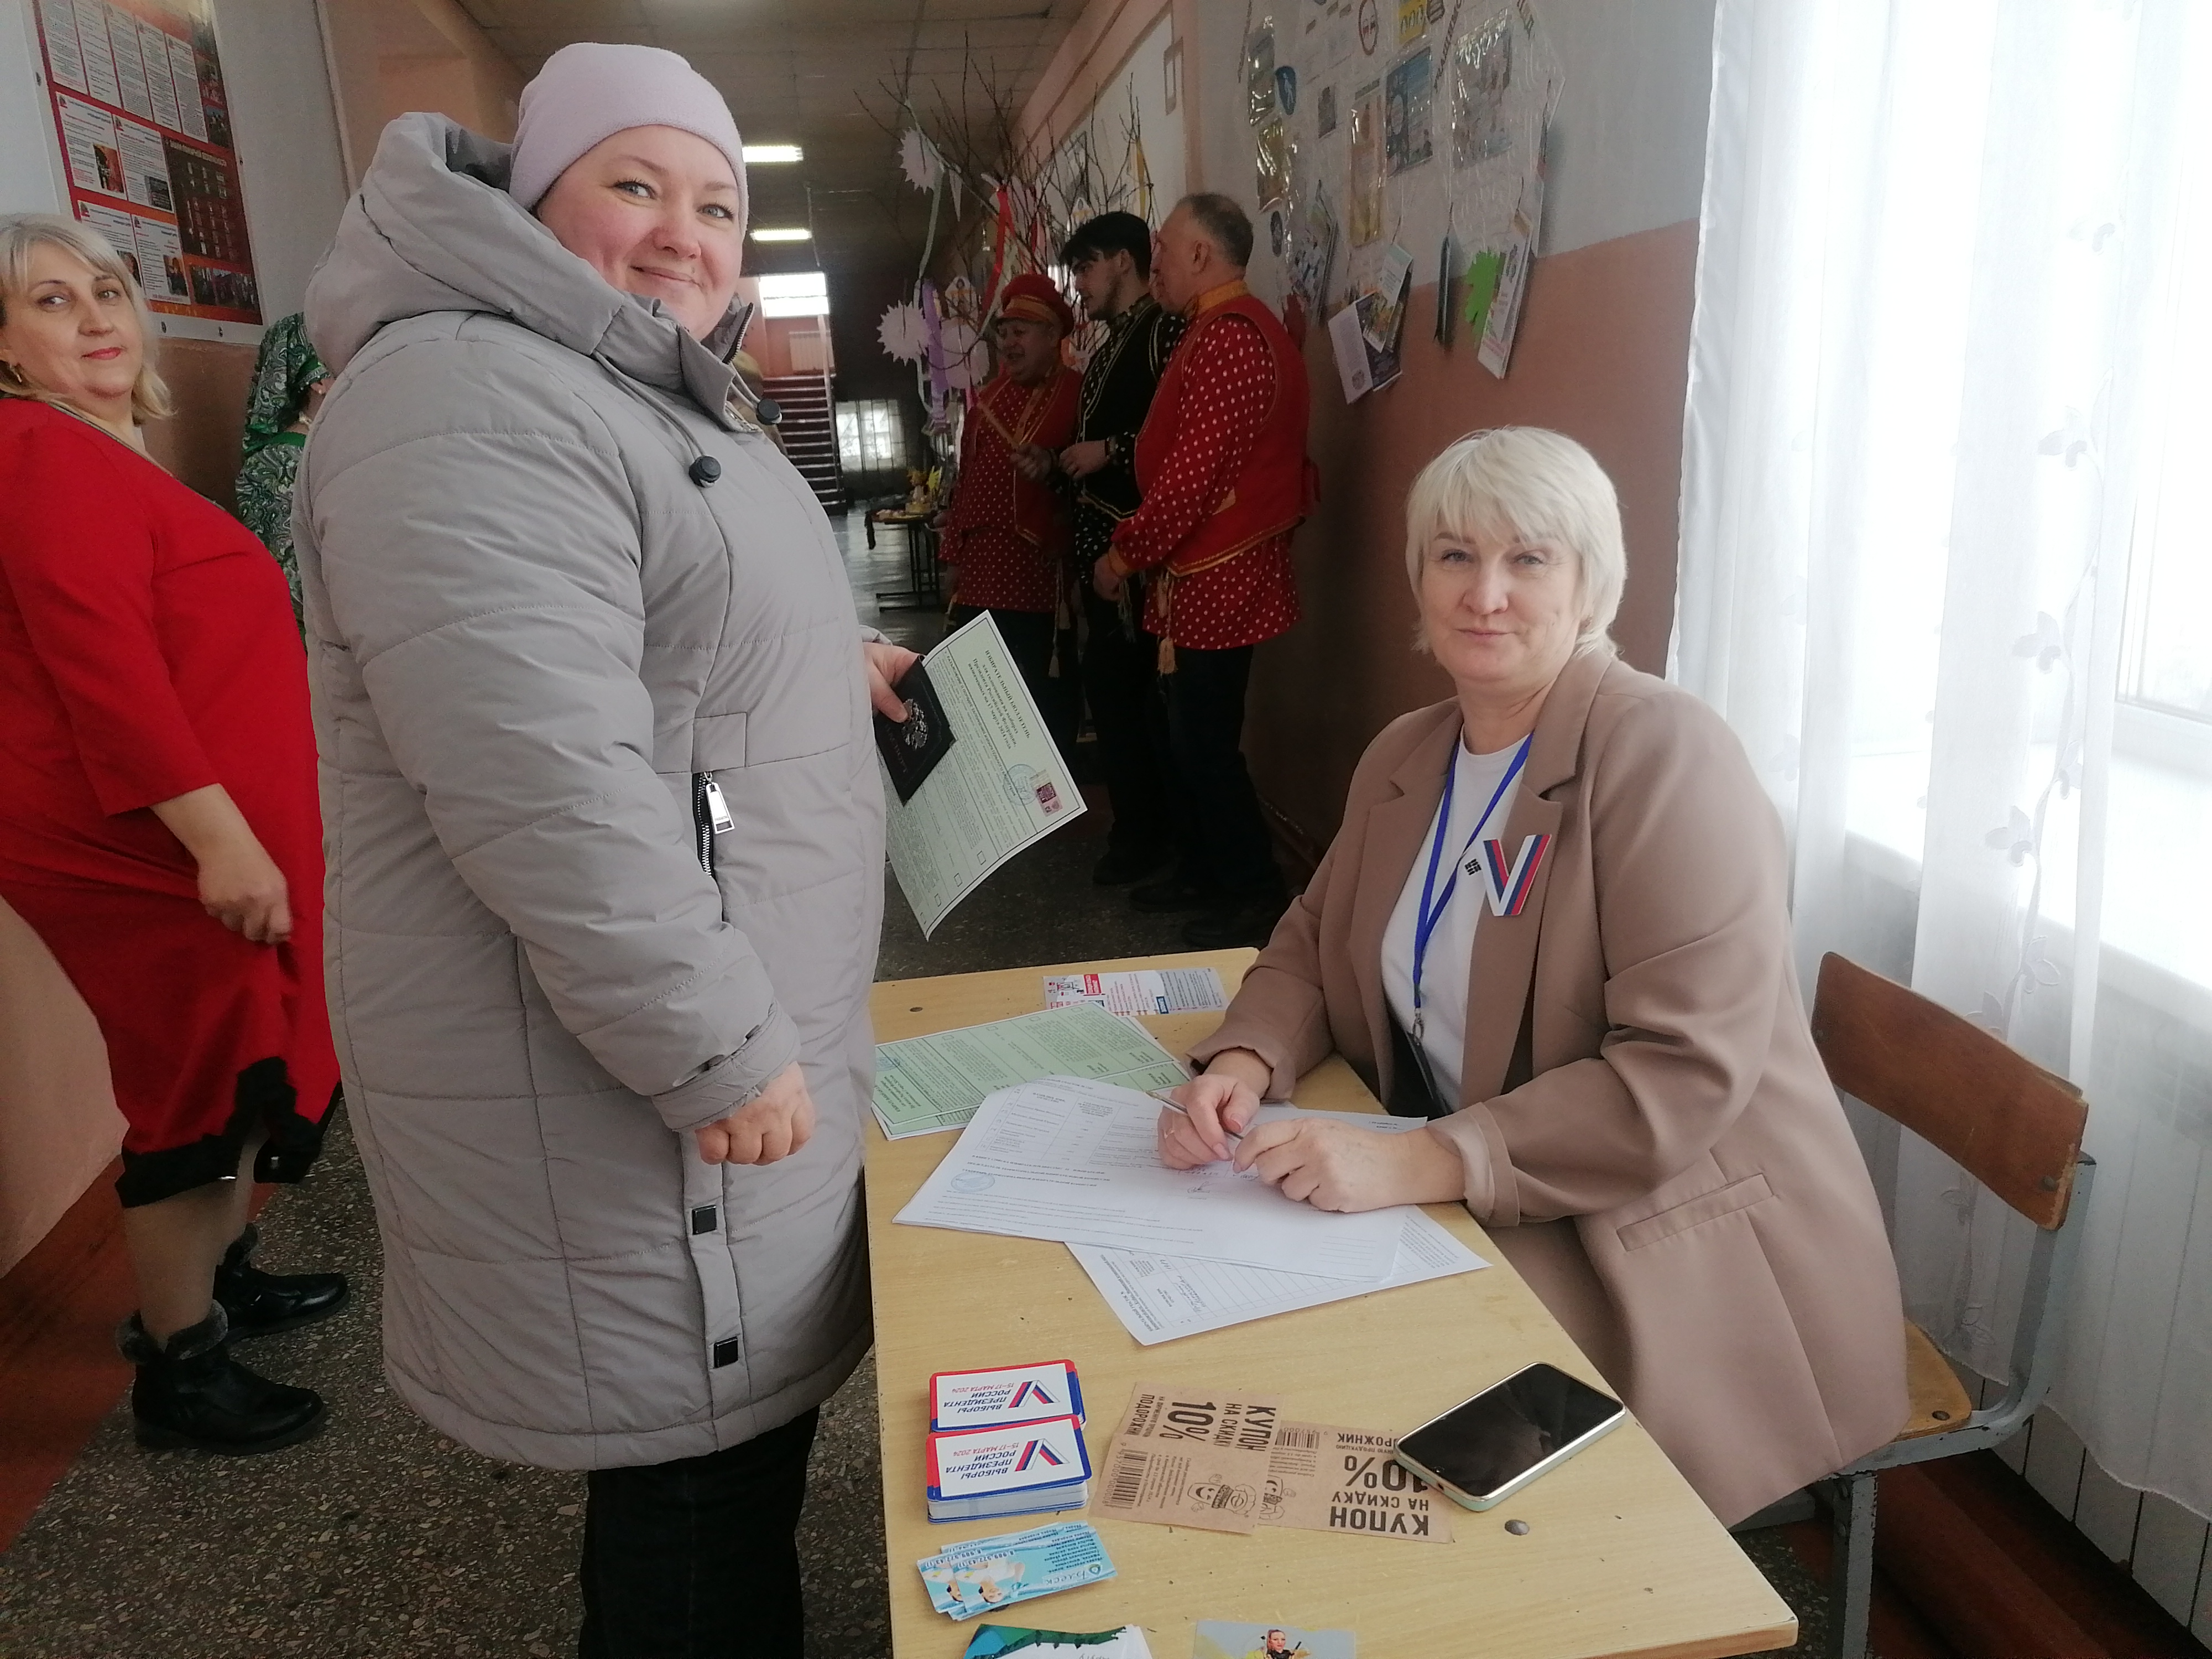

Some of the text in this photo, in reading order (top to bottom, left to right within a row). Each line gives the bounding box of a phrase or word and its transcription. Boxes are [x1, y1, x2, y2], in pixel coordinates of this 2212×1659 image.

[971, 1389, 1011, 1398] РОССИИ
[942, 1396, 1006, 1407] ПРЕЗИДЕНТА
[957, 1404, 1002, 1413] ВЫБОРЫ
[1224, 1403, 1242, 1415] НА
[1159, 1402, 1216, 1442] 10%
[1234, 1405, 1276, 1452] КУПОН
[1338, 1433, 1396, 1447] РОЖНИК
[972, 1446, 996, 1454] МАРТА
[1336, 1444, 1375, 1453] ПРОДУКЦИЮ
[973, 1449, 1016, 1461] РОССИИ
[945, 1458, 1012, 1473] ПРЕЗИДЕНТА
[961, 1467, 1008, 1479] ВЫБОРЫ
[1332, 1491, 1428, 1511] НА СКИДКУ
[1329, 1506, 1428, 1536] КУПОН
[1046, 1572, 1086, 1585] Блеск
